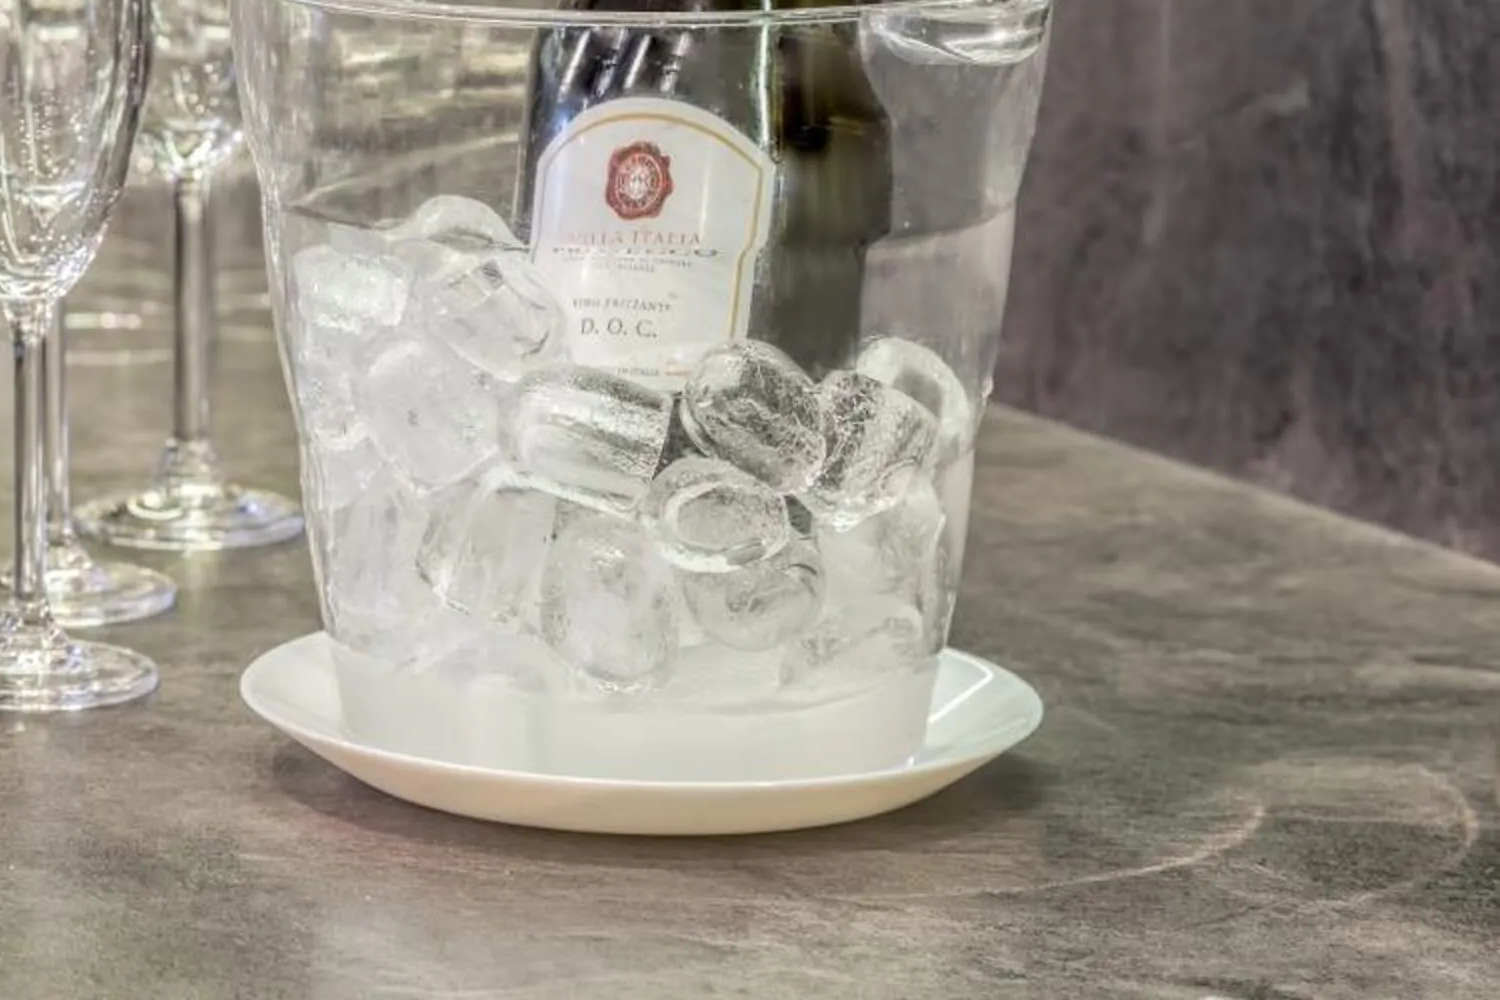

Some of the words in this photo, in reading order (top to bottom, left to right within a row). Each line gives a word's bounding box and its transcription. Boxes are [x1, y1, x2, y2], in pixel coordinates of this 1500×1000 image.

[632, 230, 701, 246] ITALIA
[580, 317, 600, 336] D.
[607, 316, 628, 336] O.
[635, 318, 658, 339] C.
